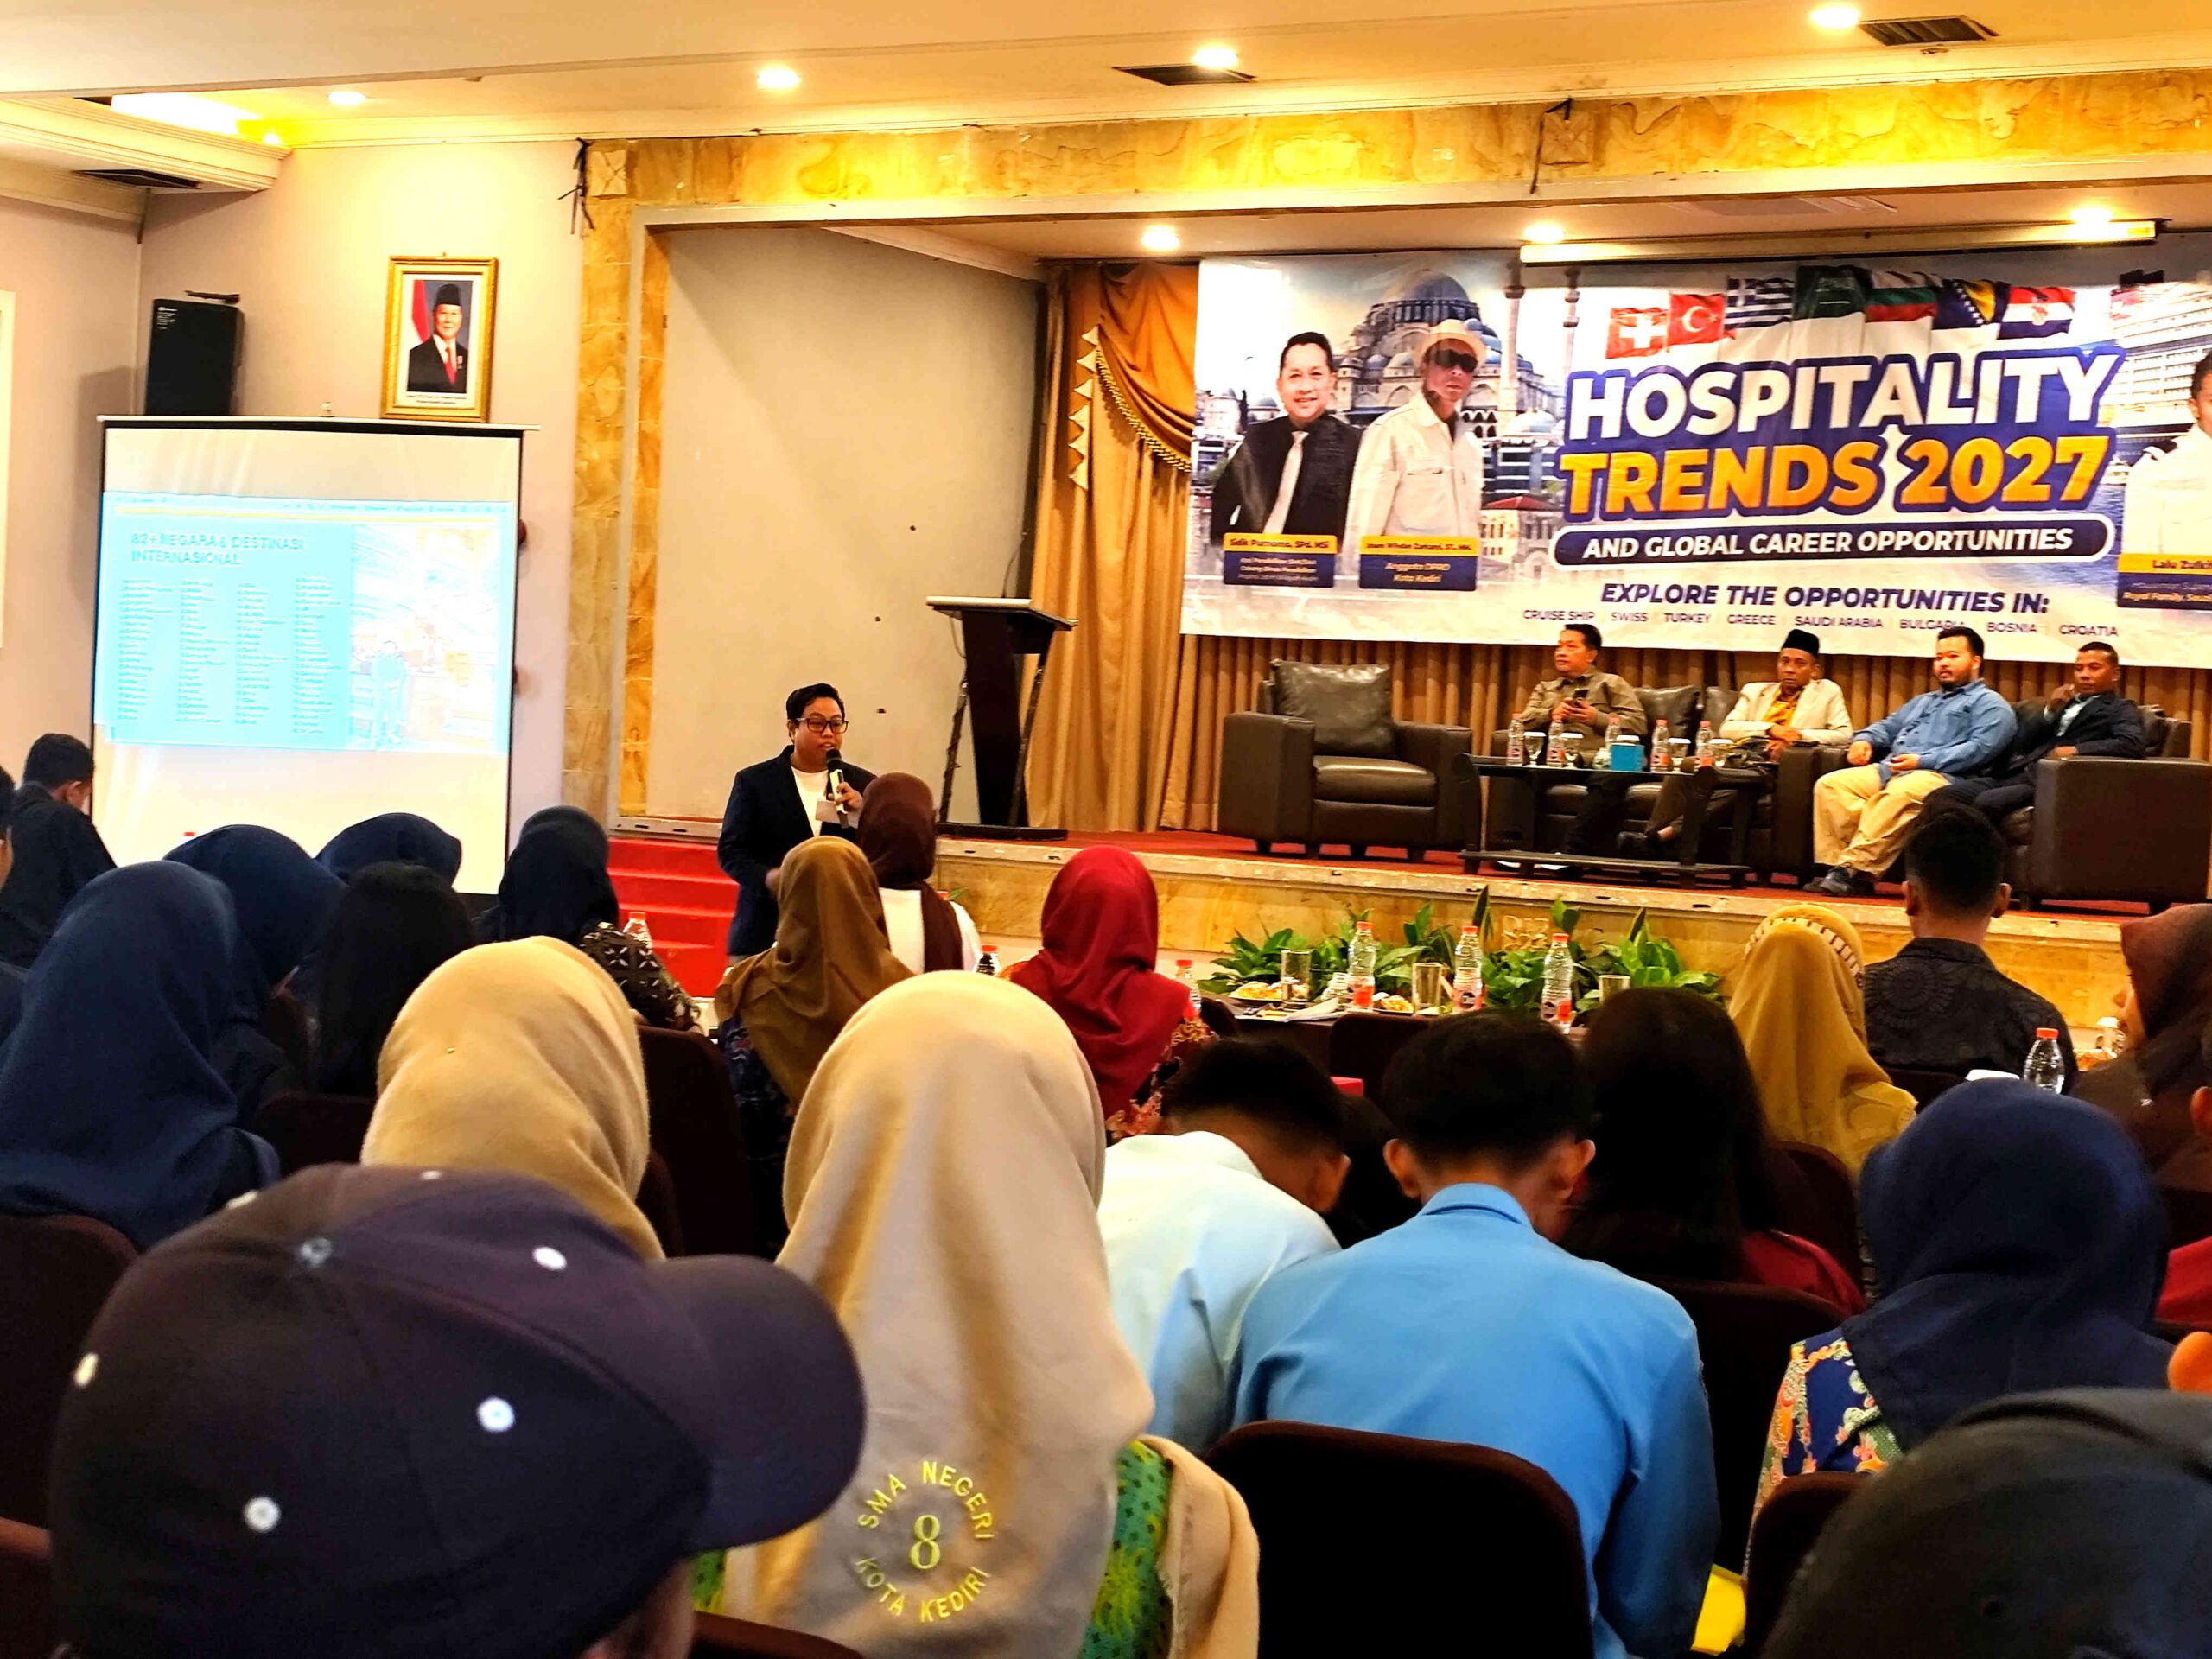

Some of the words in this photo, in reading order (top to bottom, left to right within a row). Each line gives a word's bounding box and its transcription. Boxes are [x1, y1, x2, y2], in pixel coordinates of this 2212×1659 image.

[1568, 353, 2120, 441] HOSPITALITY
[1559, 440, 1880, 515] TRENDS
[1900, 435, 2110, 505] 2027
[1582, 537, 1640, 559] AND
[1644, 534, 1745, 558] GLOBAL
[1749, 531, 1853, 555] CAREER
[1857, 527, 2075, 553] OPPORTUNITIES
[1522, 609, 1567, 621] CRUISE
[1568, 610, 1596, 622] SHIP
[1611, 611, 1649, 623] SWISS
[1663, 612, 1711, 624] TURKEY
[1726, 613, 1777, 626] GREECE
[1794, 615, 1836, 627] SAUDI
[1837, 616, 1884, 629] ARABIA
[1986, 621, 2039, 634] BOSNIA
[2058, 624, 2120, 637] CROATIA
[1600, 582, 1719, 605] EXPLORE
[1726, 585, 1777, 607] THE
[1783, 586, 2006, 613] OPPORTUNITIES
[2012, 593, 2050, 614] IN:
[857, 1472, 907, 1529] SMA
[921, 1459, 995, 1541] NEGERI
[909, 1514, 941, 1570] 8
[853, 1557, 906, 1617] KOTA
[919, 1565, 993, 1623] KEDIRI
